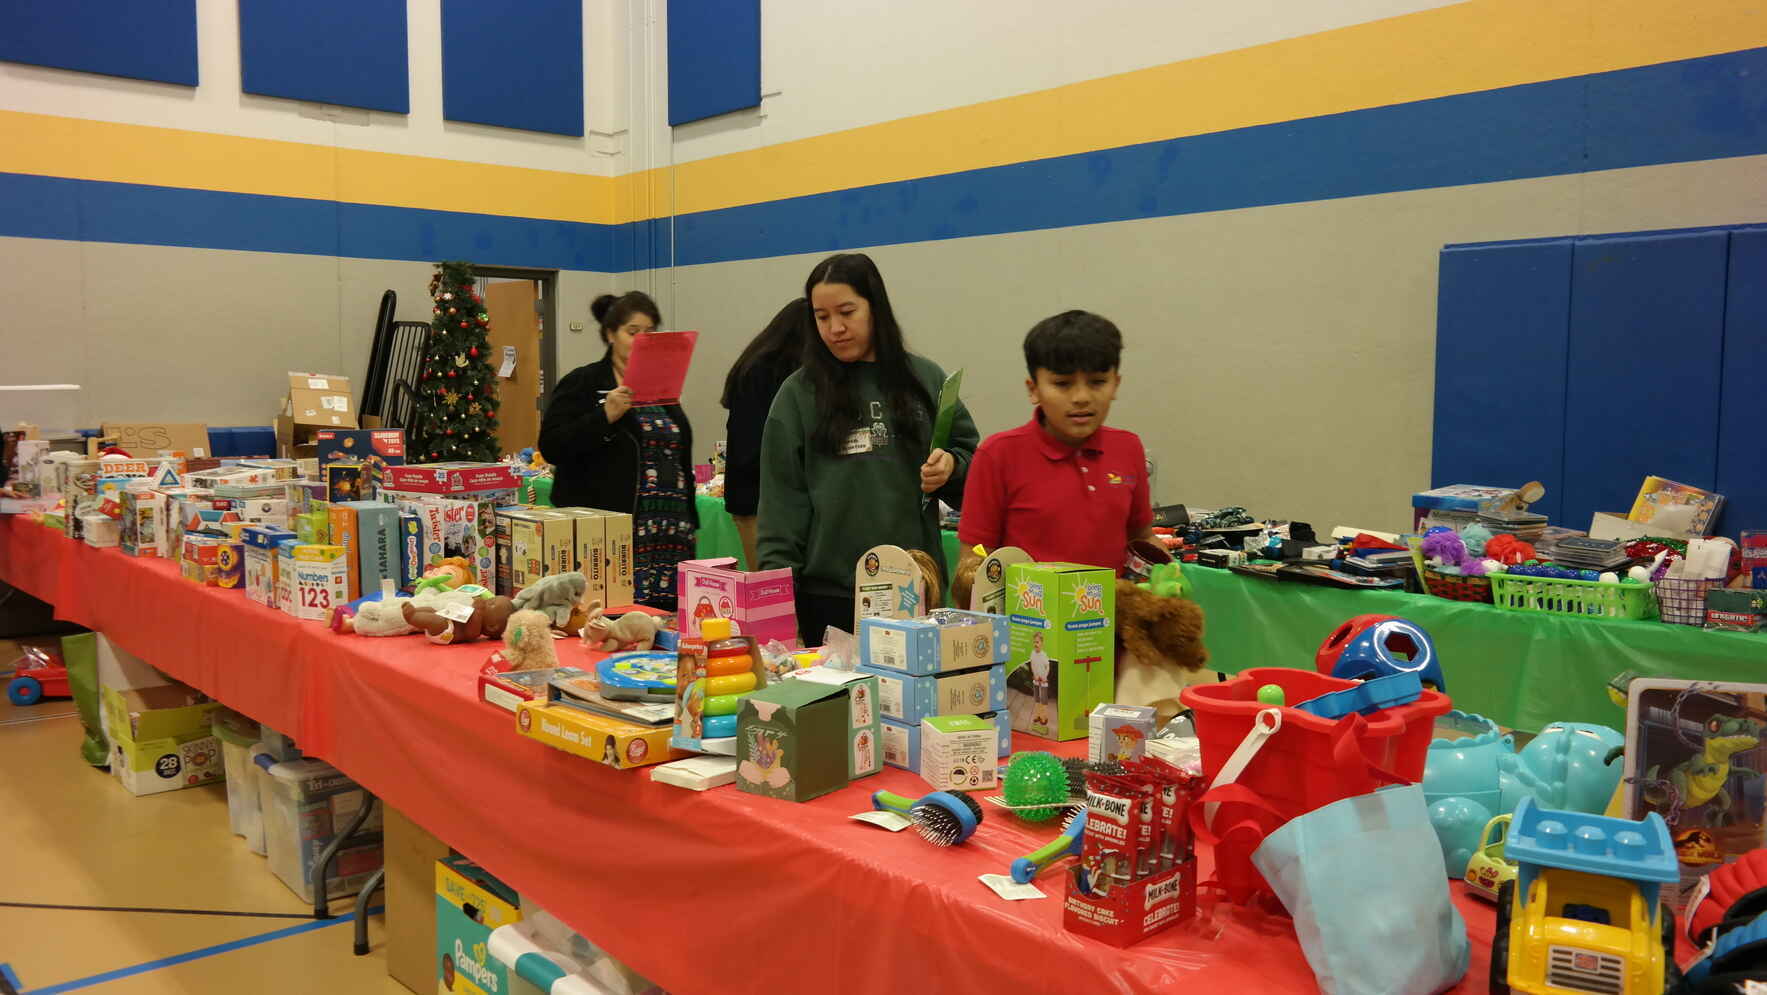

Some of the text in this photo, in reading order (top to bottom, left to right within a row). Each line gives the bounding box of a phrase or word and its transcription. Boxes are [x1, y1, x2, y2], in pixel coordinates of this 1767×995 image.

[103, 462, 146, 474] DEER
[429, 507, 441, 542] Twister
[378, 528, 388, 573] SAHARA
[297, 570, 329, 583] Numbers
[298, 587, 330, 608] 123
[1022, 591, 1046, 616] Sun
[1079, 594, 1105, 615] Sun
[160, 757, 178, 770] 28
[455, 938, 498, 993] Pampers
